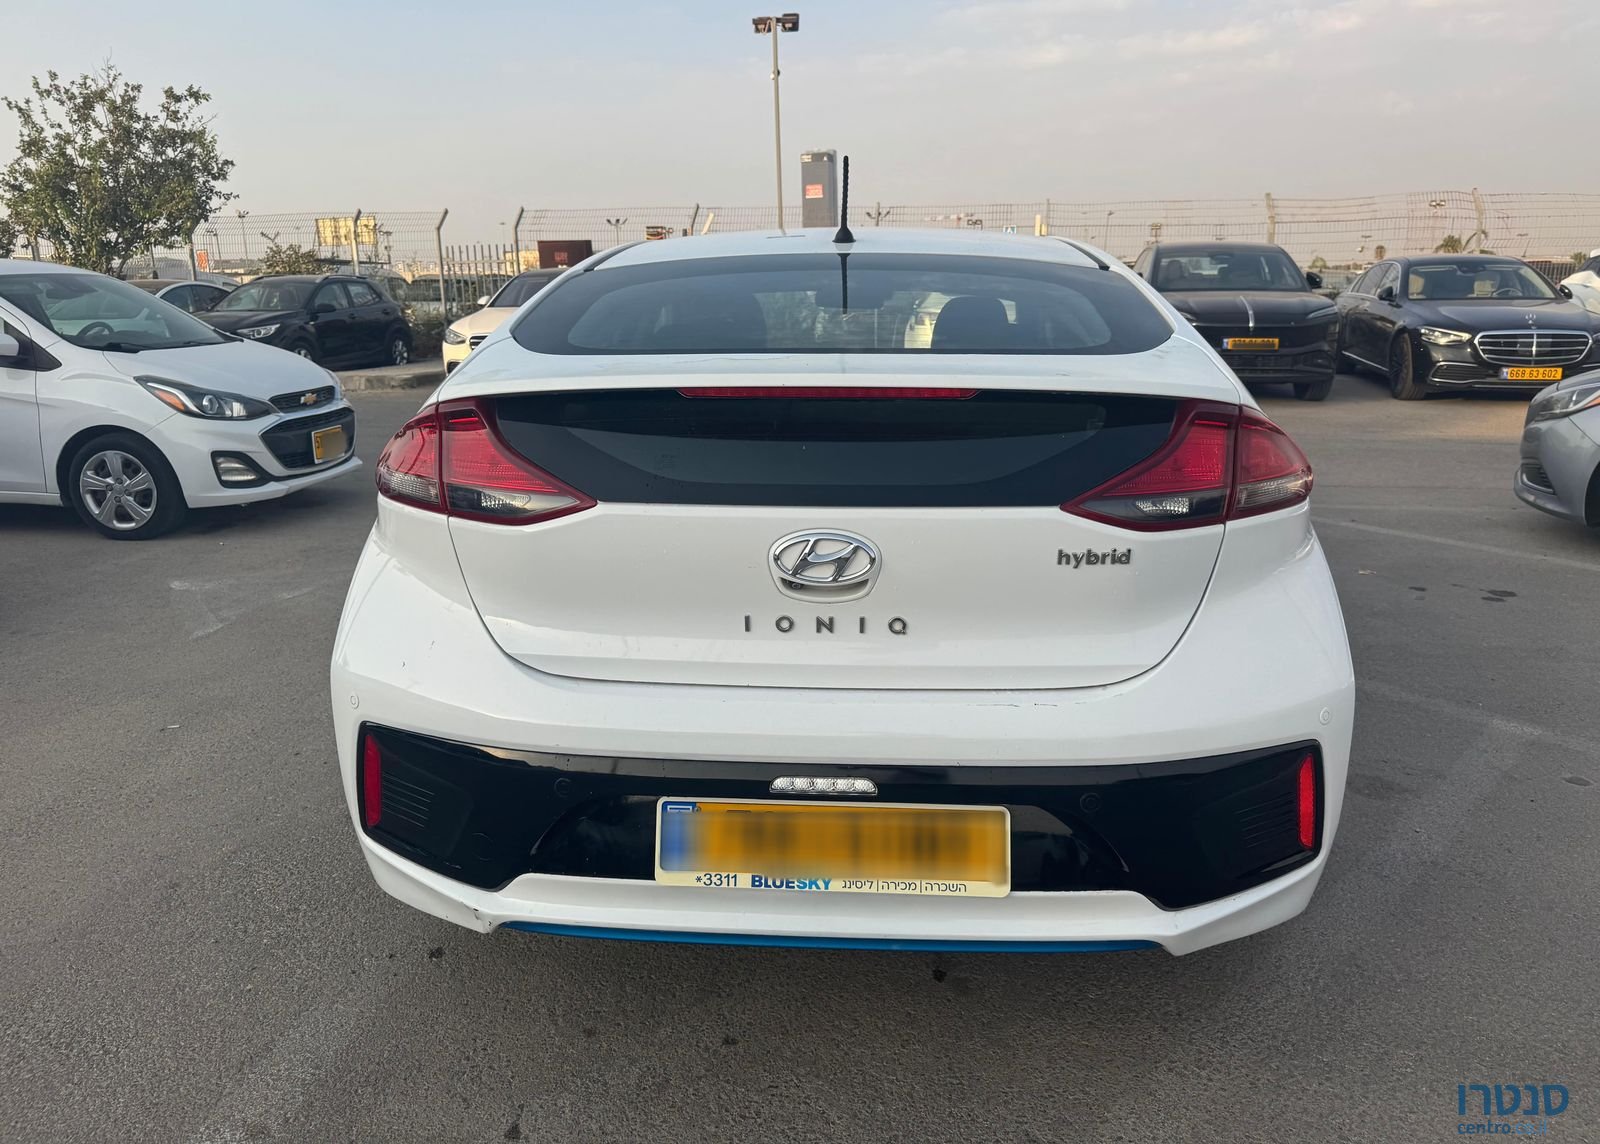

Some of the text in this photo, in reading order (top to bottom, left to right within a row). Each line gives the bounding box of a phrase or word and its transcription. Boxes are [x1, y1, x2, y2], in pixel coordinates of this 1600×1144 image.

[1057, 548, 1132, 569] hybrid
[744, 615, 908, 635] IONIQ
[751, 874, 833, 891] BLUESKY
[841, 879, 967, 893] השכרה מכירה ליסינג
